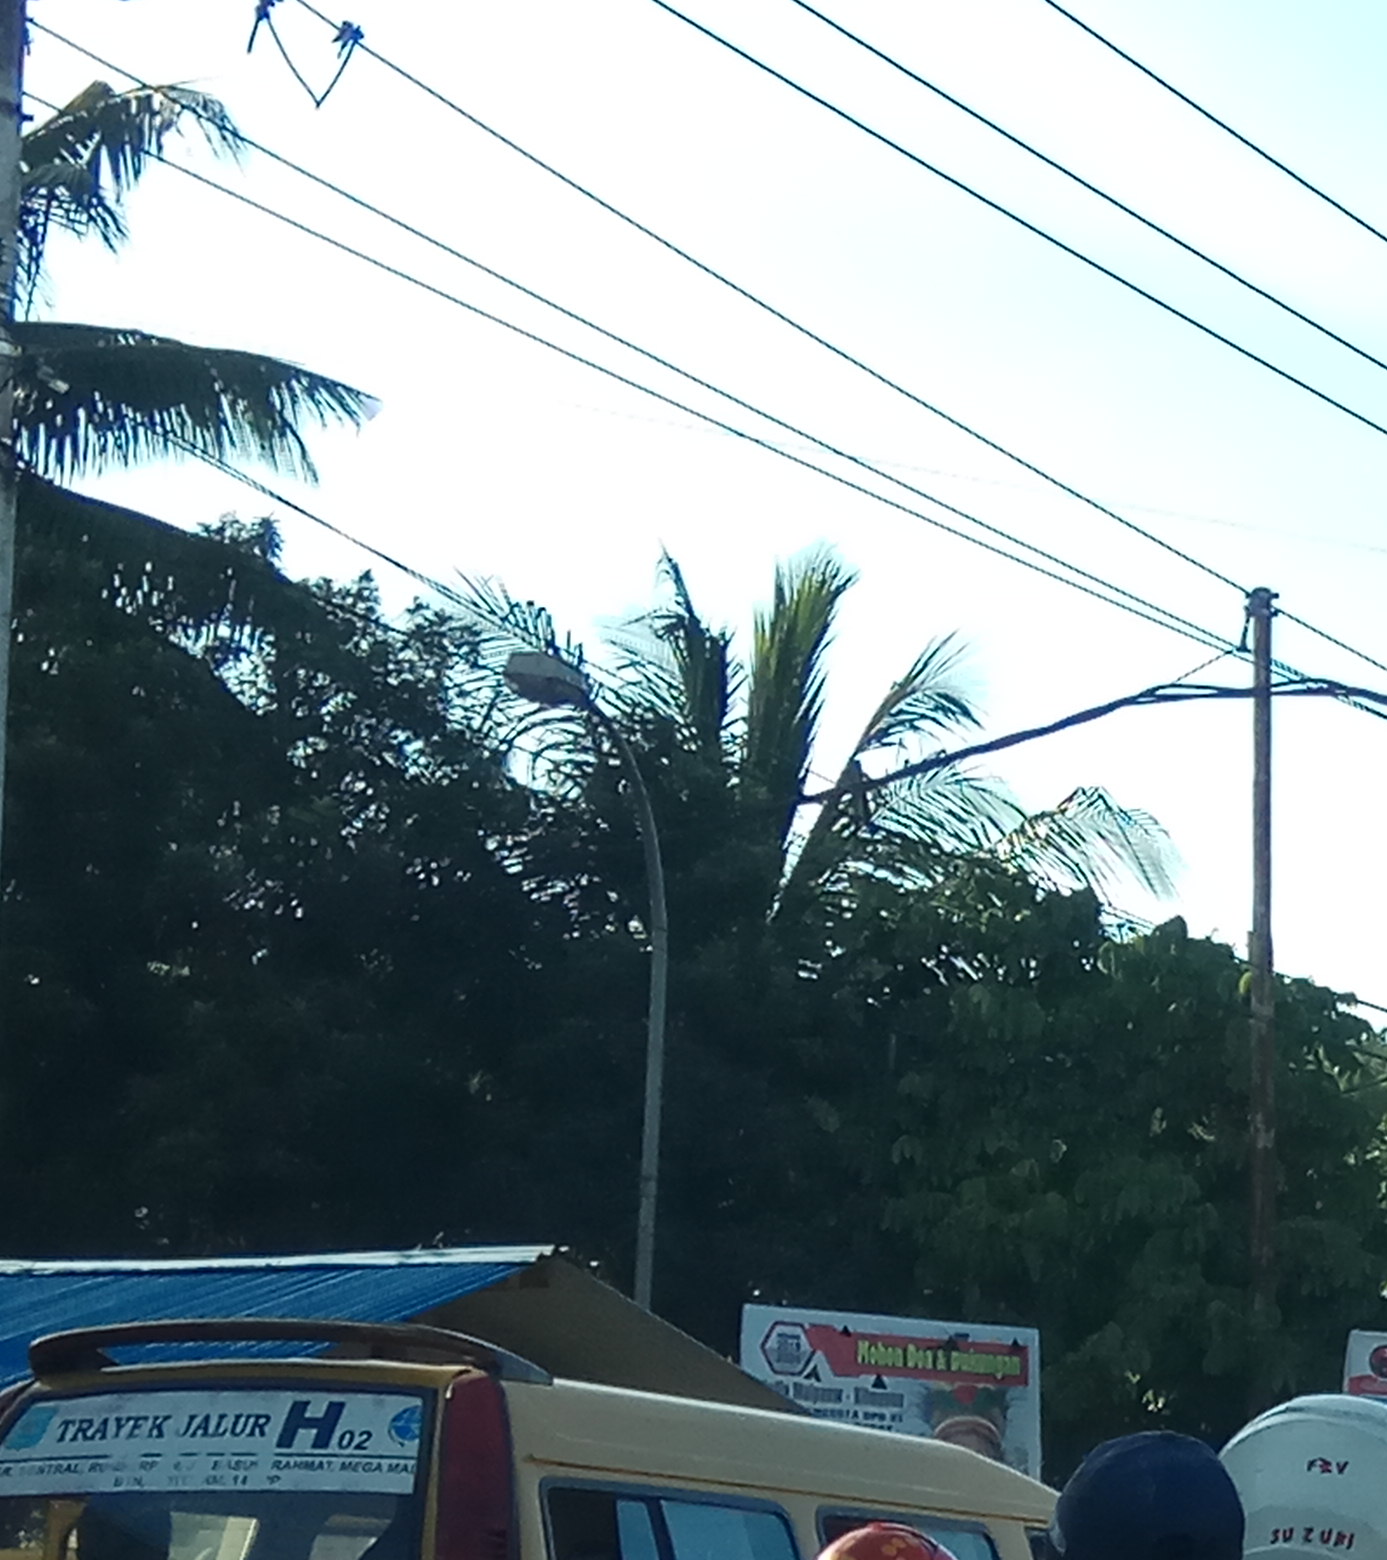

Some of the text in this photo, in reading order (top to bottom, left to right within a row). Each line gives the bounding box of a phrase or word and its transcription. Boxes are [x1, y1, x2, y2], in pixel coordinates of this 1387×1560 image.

[176, 1411, 272, 1439] JALUR
[276, 1400, 346, 1449] H
[338, 1430, 373, 1450] 02
